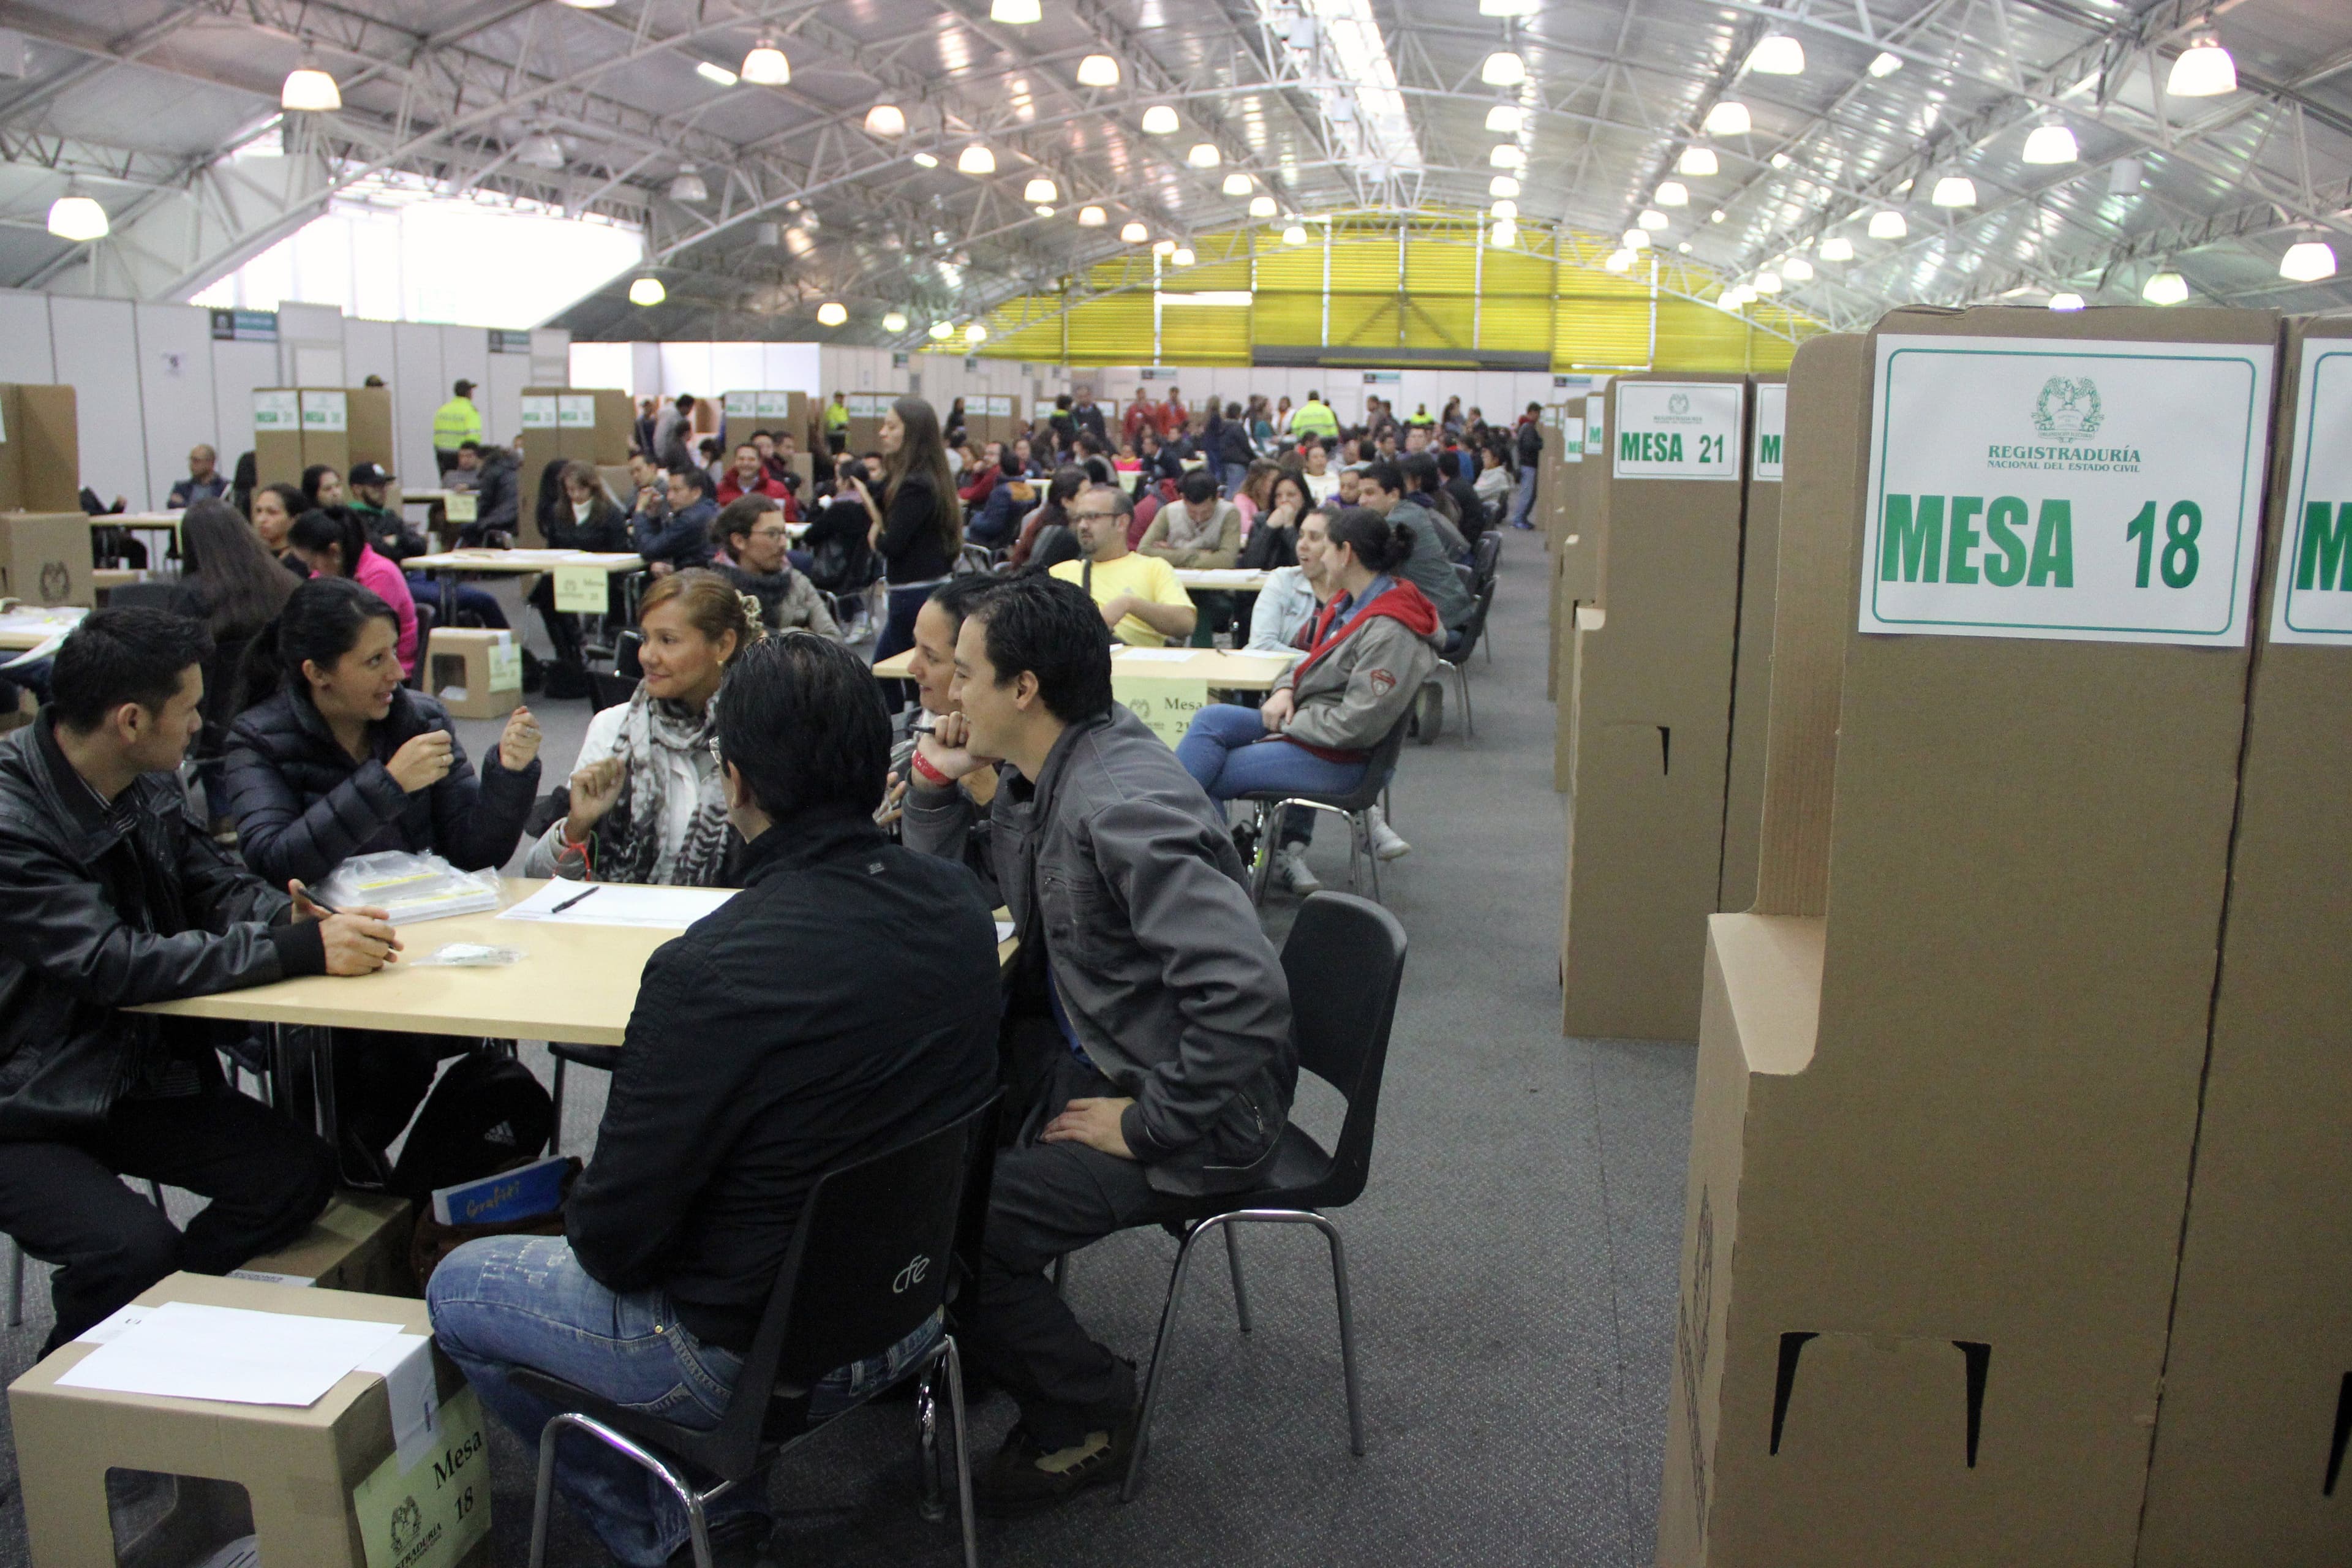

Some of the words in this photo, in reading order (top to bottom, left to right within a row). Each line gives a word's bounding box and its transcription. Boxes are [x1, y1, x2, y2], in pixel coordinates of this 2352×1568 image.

[1621, 432, 1683, 462] MESA
[1698, 434, 1724, 463] 21
[1988, 445, 2141, 462] REGISTRADURÍA
[1988, 460, 2040, 470] NACIONAL
[2043, 462, 2065, 470] DEL
[2068, 463, 2110, 472] ESTADO
[2113, 464, 2141, 473] CIVIL
[1881, 494, 2074, 588] MESA
[2126, 500, 2203, 589] 18
[1164, 696, 1203, 710] Mesa
[432, 1431, 483, 1490] Mesa
[454, 1486, 473, 1523] 18
